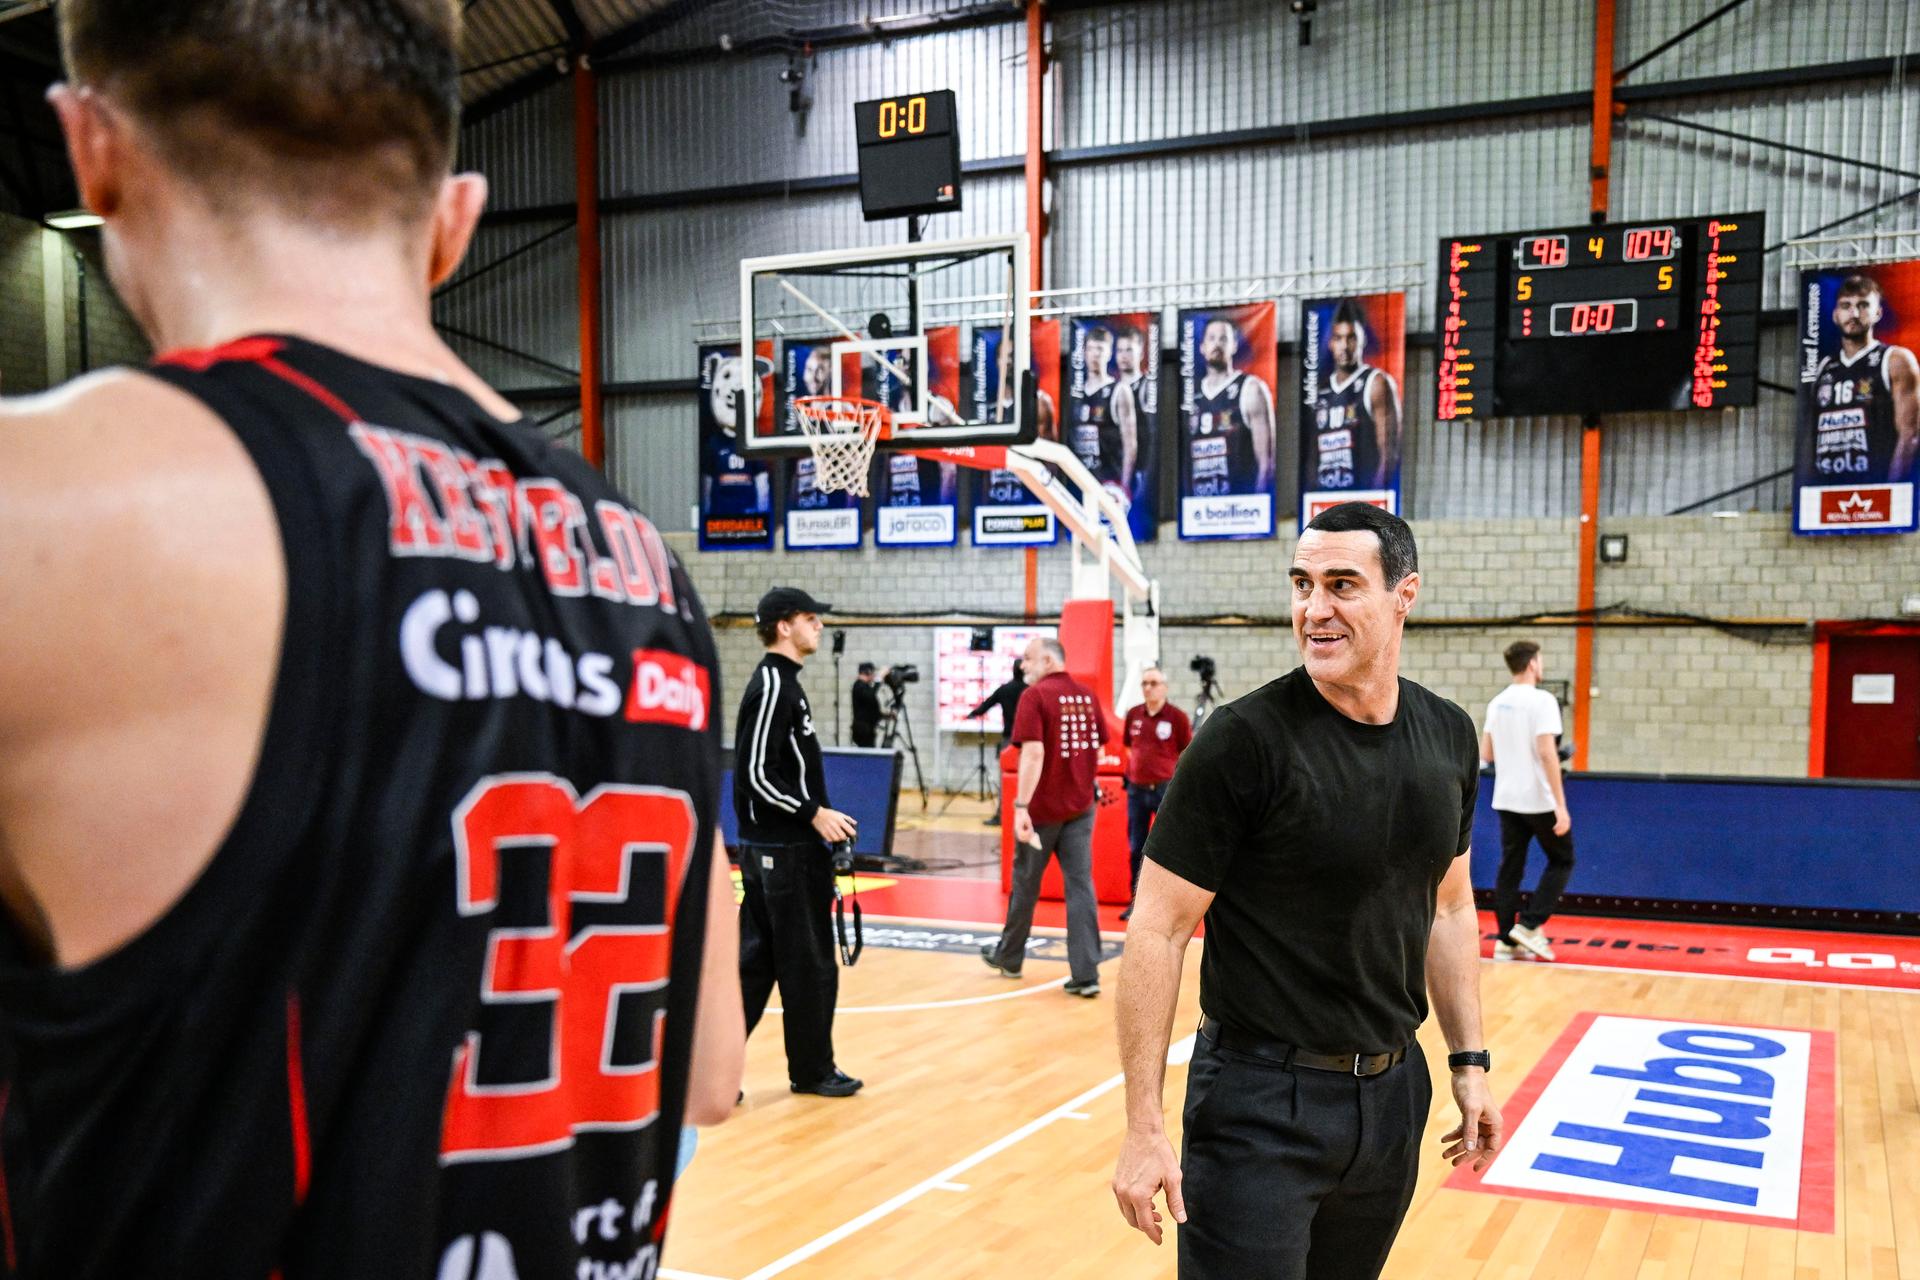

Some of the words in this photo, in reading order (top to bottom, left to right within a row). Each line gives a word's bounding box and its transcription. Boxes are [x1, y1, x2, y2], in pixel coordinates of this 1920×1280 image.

[879, 97, 926, 138] 0:0
[1532, 238, 1567, 266] 96
[1588, 238, 1604, 259] 4
[1626, 229, 1672, 260] 104
[1517, 276, 1532, 300] 5
[1657, 266, 1673, 291] 5
[1571, 303, 1615, 333] 0:0
[1834, 380, 1854, 405] 16
[1820, 414, 1861, 428] Hubo
[1530, 1029, 1786, 1207] Hubo
